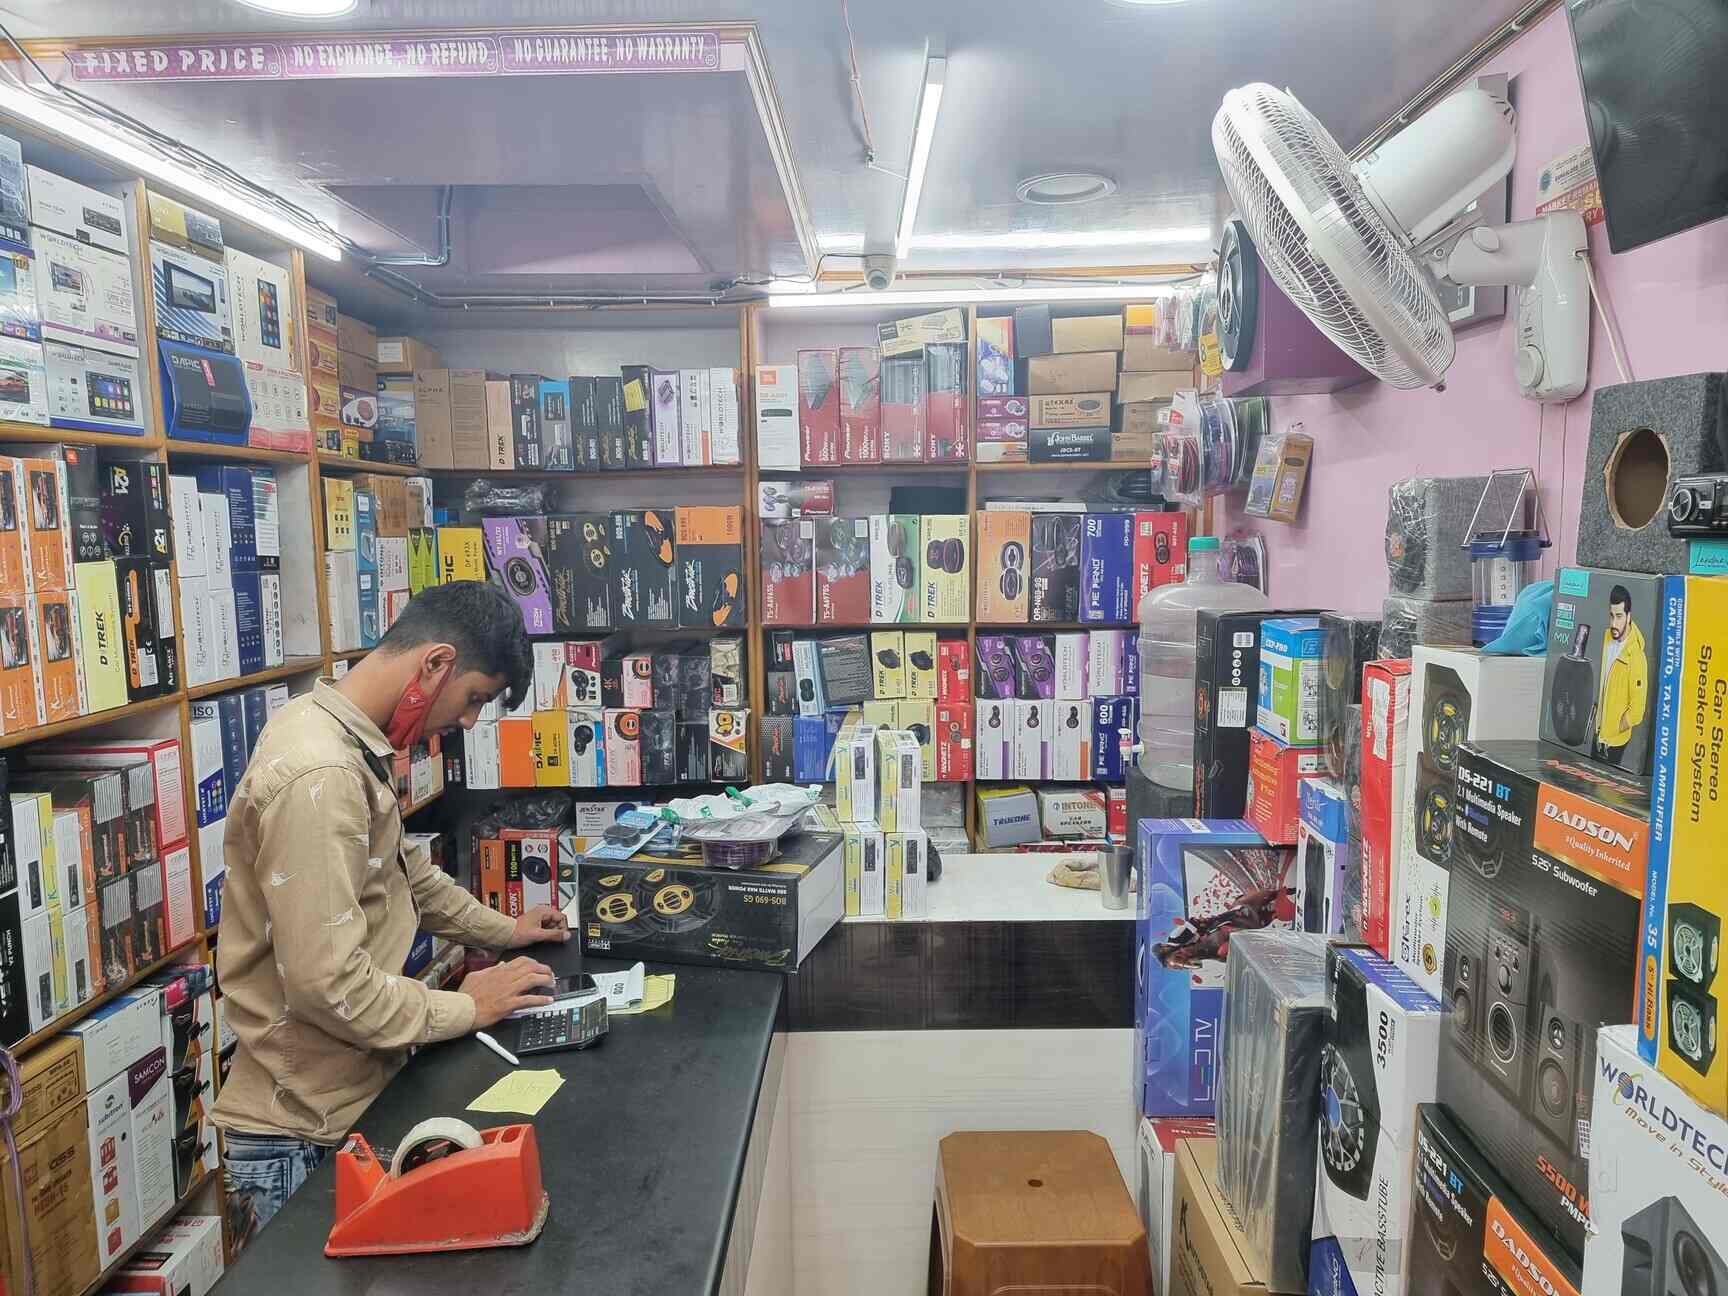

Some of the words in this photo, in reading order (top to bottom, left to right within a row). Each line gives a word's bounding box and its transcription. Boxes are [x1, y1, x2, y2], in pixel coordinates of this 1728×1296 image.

[85, 49, 168, 73] FIXED
[178, 47, 265, 72] PRICE
[292, 46, 312, 66] NO
[405, 43, 427, 65] NO
[431, 41, 489, 64] REFUND
[513, 39, 532, 62] NO
[615, 39, 632, 61] NO
[636, 36, 705, 61] WARRANTY
[1087, 519, 1096, 537] 700
[1696, 644, 1713, 731] Speaker
[1716, 678, 1728, 720] Car
[193, 706, 214, 718] ISO
[1099, 704, 1108, 725] 600
[1707, 724, 1724, 801] Stereo
[1495, 782, 1511, 799] BT
[1690, 734, 1706, 824] System
[1464, 789, 1496, 817] Multimedia
[1497, 802, 1523, 828] Speaker
[1655, 763, 1668, 842] AMPLIFIER
[1543, 801, 1633, 853] DADSON
[1553, 866, 1598, 898] Subwoofer
[1647, 923, 1658, 949] 35
[1194, 1017, 1212, 1042] TV
[1376, 1012, 1388, 1069] 3500
[1449, 1168, 1463, 1195] BT
